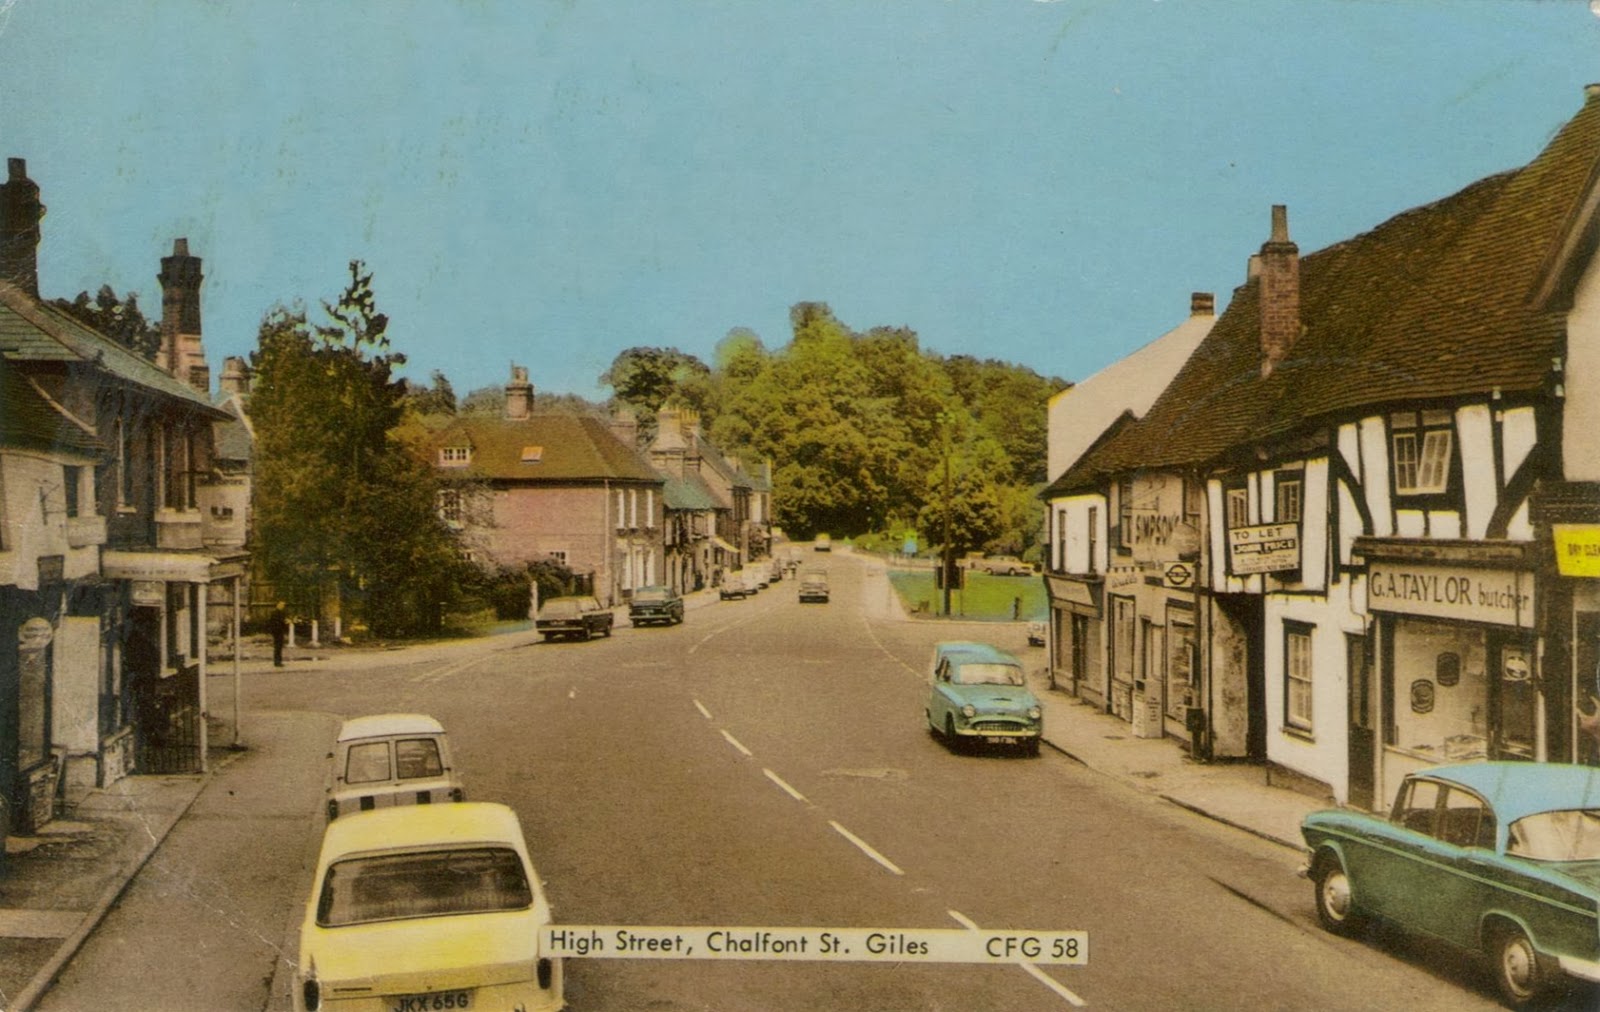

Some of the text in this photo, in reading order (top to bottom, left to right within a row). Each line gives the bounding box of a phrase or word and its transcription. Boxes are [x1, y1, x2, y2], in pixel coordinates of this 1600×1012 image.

[1234, 527, 1283, 540] TO LET
[394, 993, 469, 1012] JKX 65G
